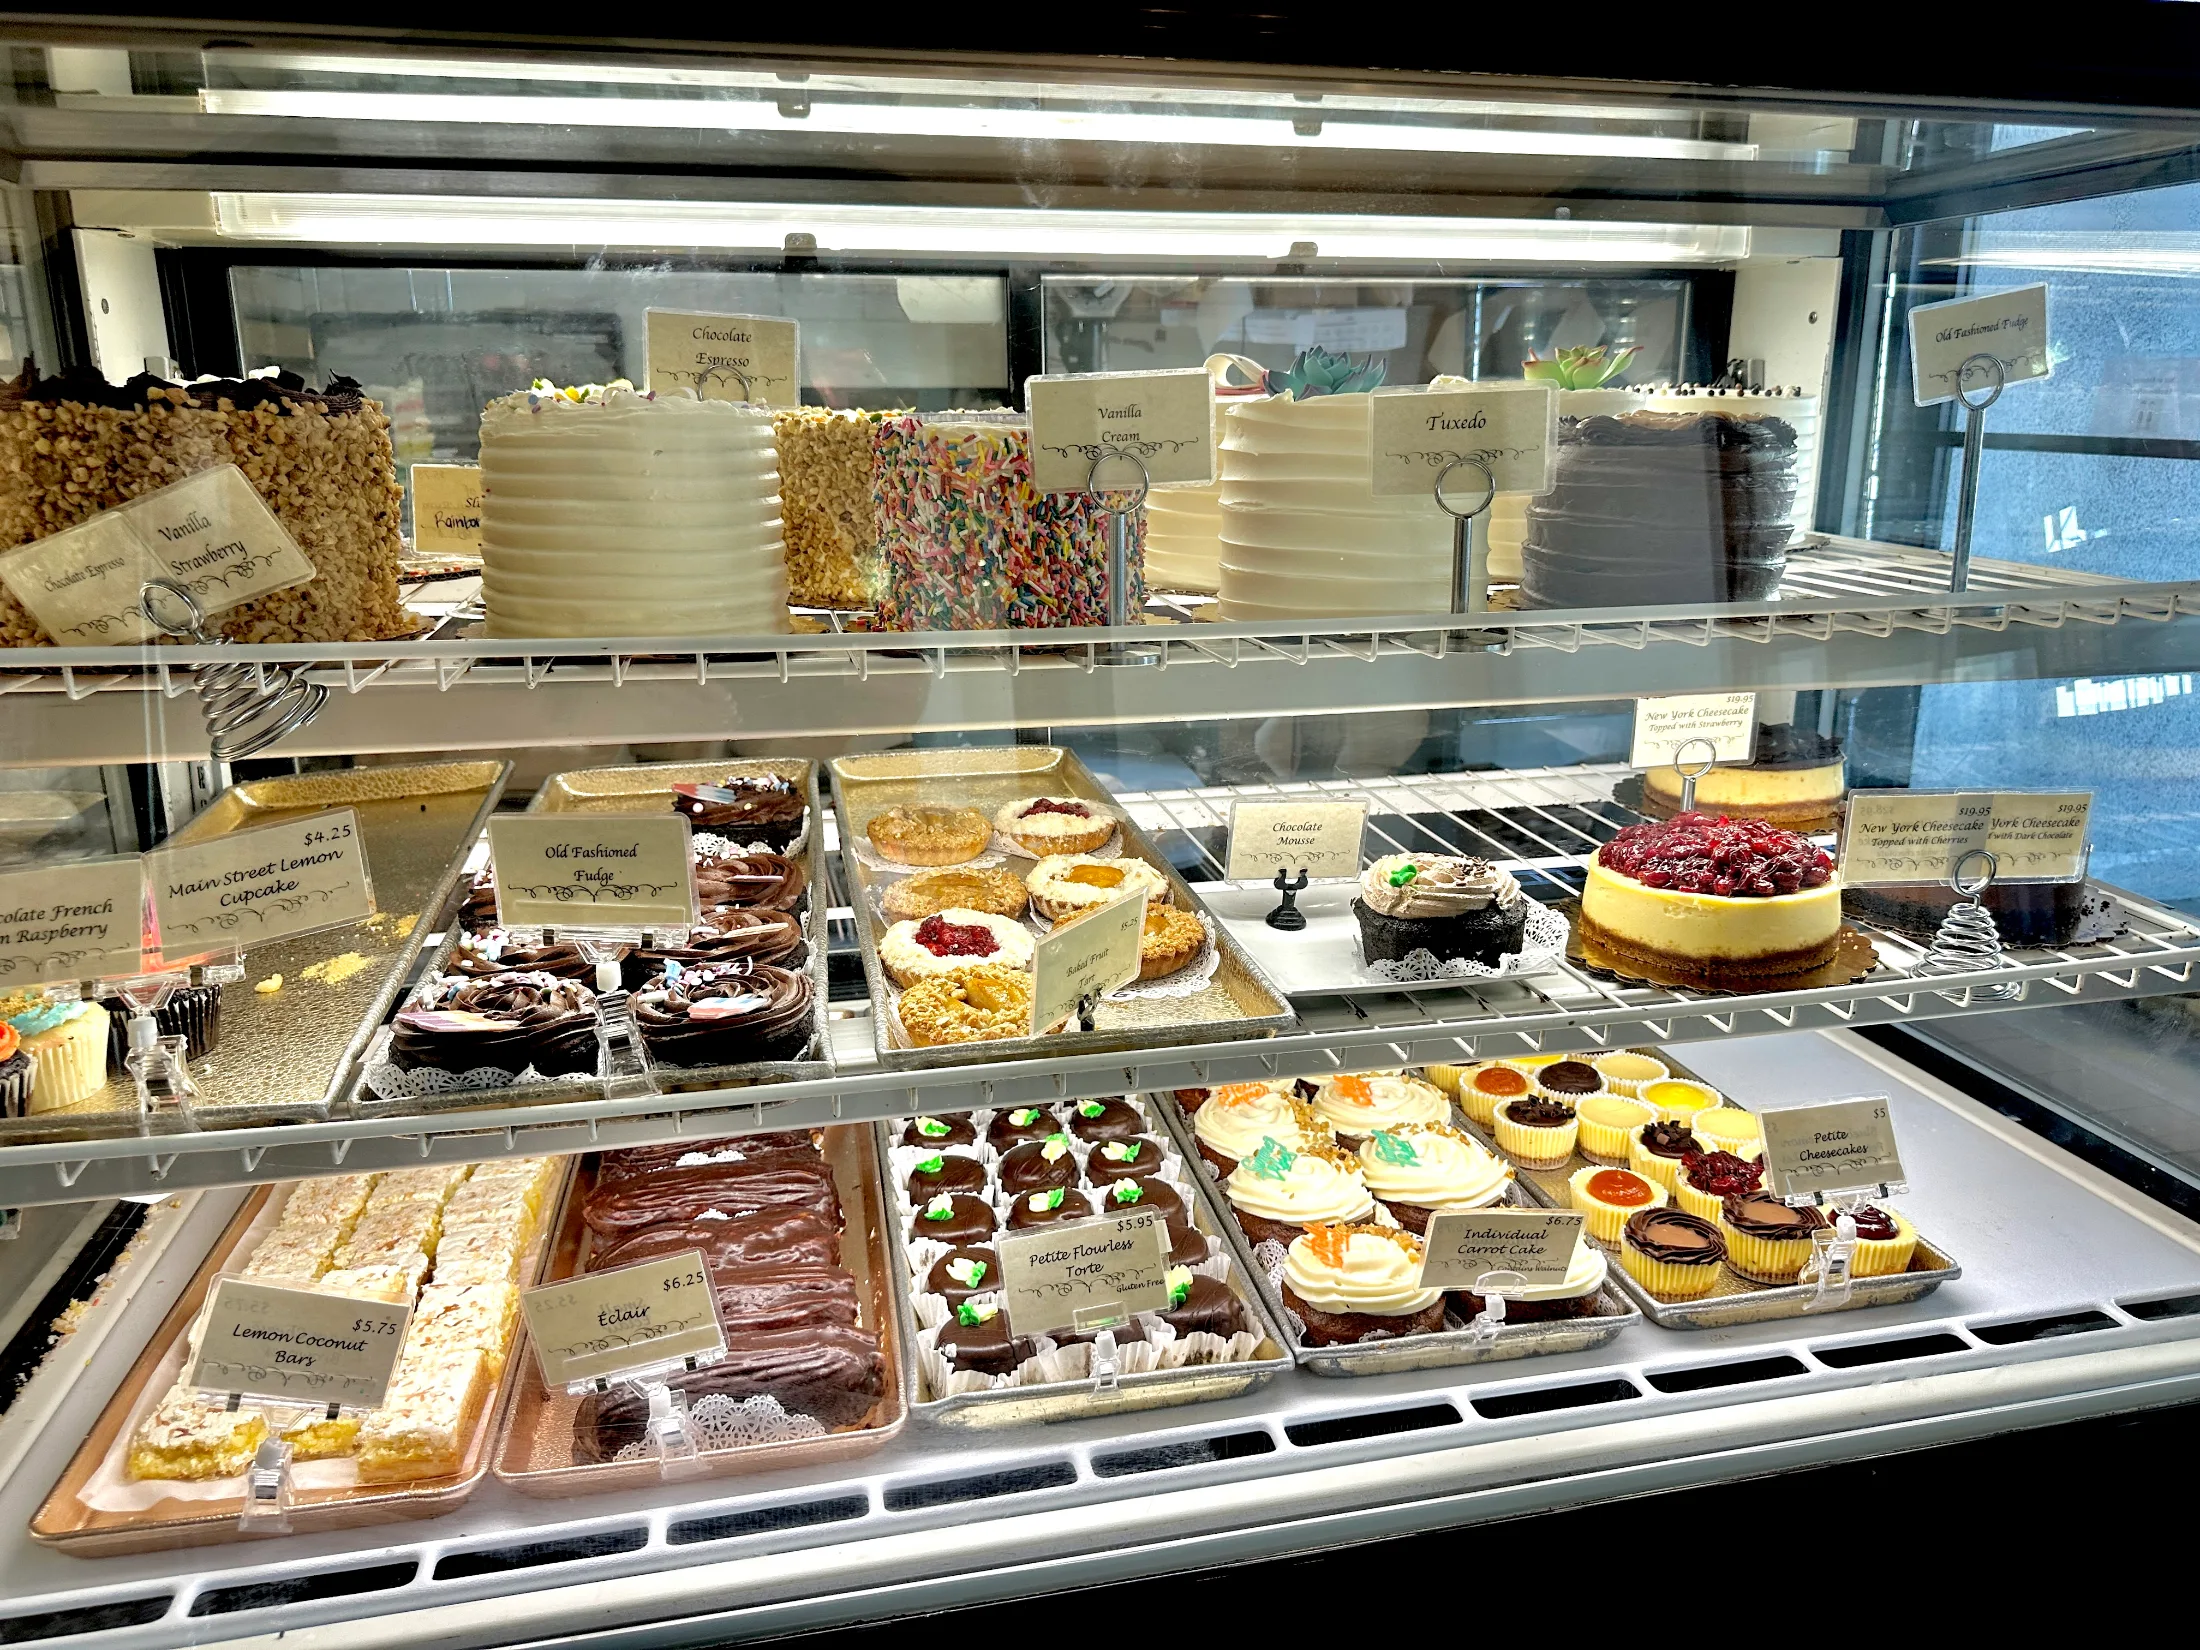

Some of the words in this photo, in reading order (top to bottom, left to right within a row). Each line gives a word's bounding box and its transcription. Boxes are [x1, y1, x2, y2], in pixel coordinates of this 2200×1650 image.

[692, 325, 752, 343] Chocolate
[1935, 327, 1954, 342] Old
[1953, 319, 2000, 339] Fashioned
[2001, 313, 2029, 331] Fudge
[695, 352, 750, 367] Espresso
[1098, 403, 1142, 419] Vanilla
[1426, 410, 1487, 431] Tuxedo
[1101, 431, 1140, 443] Cream
[465, 496, 480, 508] Sli
[158, 510, 212, 542] Vanilla
[171, 538, 248, 577] Strawberry
[44, 569, 86, 593] Chocolate
[86, 556, 126, 581] Espresso
[1726, 695, 1754, 703] $19.95
[1644, 711, 1668, 721] New
[1671, 708, 1695, 721] York
[1696, 706, 1749, 718] Cheesecake
[1648, 722, 1676, 734] Topped
[1678, 721, 1697, 729] with
[1699, 719, 1743, 729] Strawberry
[1959, 807, 1991, 817] $19.95
[2057, 804, 2088, 813] $19.95
[1272, 821, 1323, 832] Chocolate
[1858, 822, 1888, 834] New
[1890, 820, 1920, 835] York
[1922, 819, 1985, 833] Cheesecake
[1991, 816, 2020, 830] York
[2022, 816, 2081, 828] Cheesecake
[303, 824, 351, 847] $4.25
[1276, 836, 1315, 846] Mousse
[1871, 836, 1905, 849] Topped
[1907, 837, 1929, 845] with
[1930, 836, 1968, 846] Cherries
[1993, 832, 2013, 840] with
[2014, 832, 2036, 840] Dark
[2037, 831, 2074, 840] Chocolate
[545, 843, 570, 859] Old
[571, 843, 639, 859] Fashioned
[168, 878, 221, 899] Main
[223, 862, 276, 885] Street
[280, 849, 344, 873] Lemon
[573, 867, 614, 886] Fudge
[219, 879, 300, 907] Cupcake
[49, 898, 113, 921] French
[16, 923, 108, 945] Raspberry
[1066, 953, 1090, 978] Baked
[1090, 947, 1110, 965] Fruit
[1077, 973, 1096, 989] Tart
[1873, 1107, 1886, 1119] $5
[1814, 1130, 1849, 1144] Petite
[1799, 1143, 1869, 1162] Cheesecakes
[1117, 1215, 1153, 1233] $5.95
[1545, 1216, 1583, 1226] $6.75
[1463, 1228, 1549, 1240] Individual
[1029, 1249, 1072, 1267] Petite
[1073, 1239, 1134, 1260] Flourless
[1457, 1244, 1508, 1255] Carrot
[1509, 1244, 1547, 1255] Cake
[1066, 1262, 1105, 1278] Torte
[663, 1271, 704, 1292] $6.25
[1116, 1281, 1146, 1294] Gluten
[1146, 1279, 1165, 1289] Free
[598, 1305, 651, 1327] Éclair
[352, 1318, 398, 1335] $5.75
[232, 1323, 294, 1344] Lemon
[295, 1332, 368, 1352] Coconut
[274, 1350, 316, 1367] Bars
